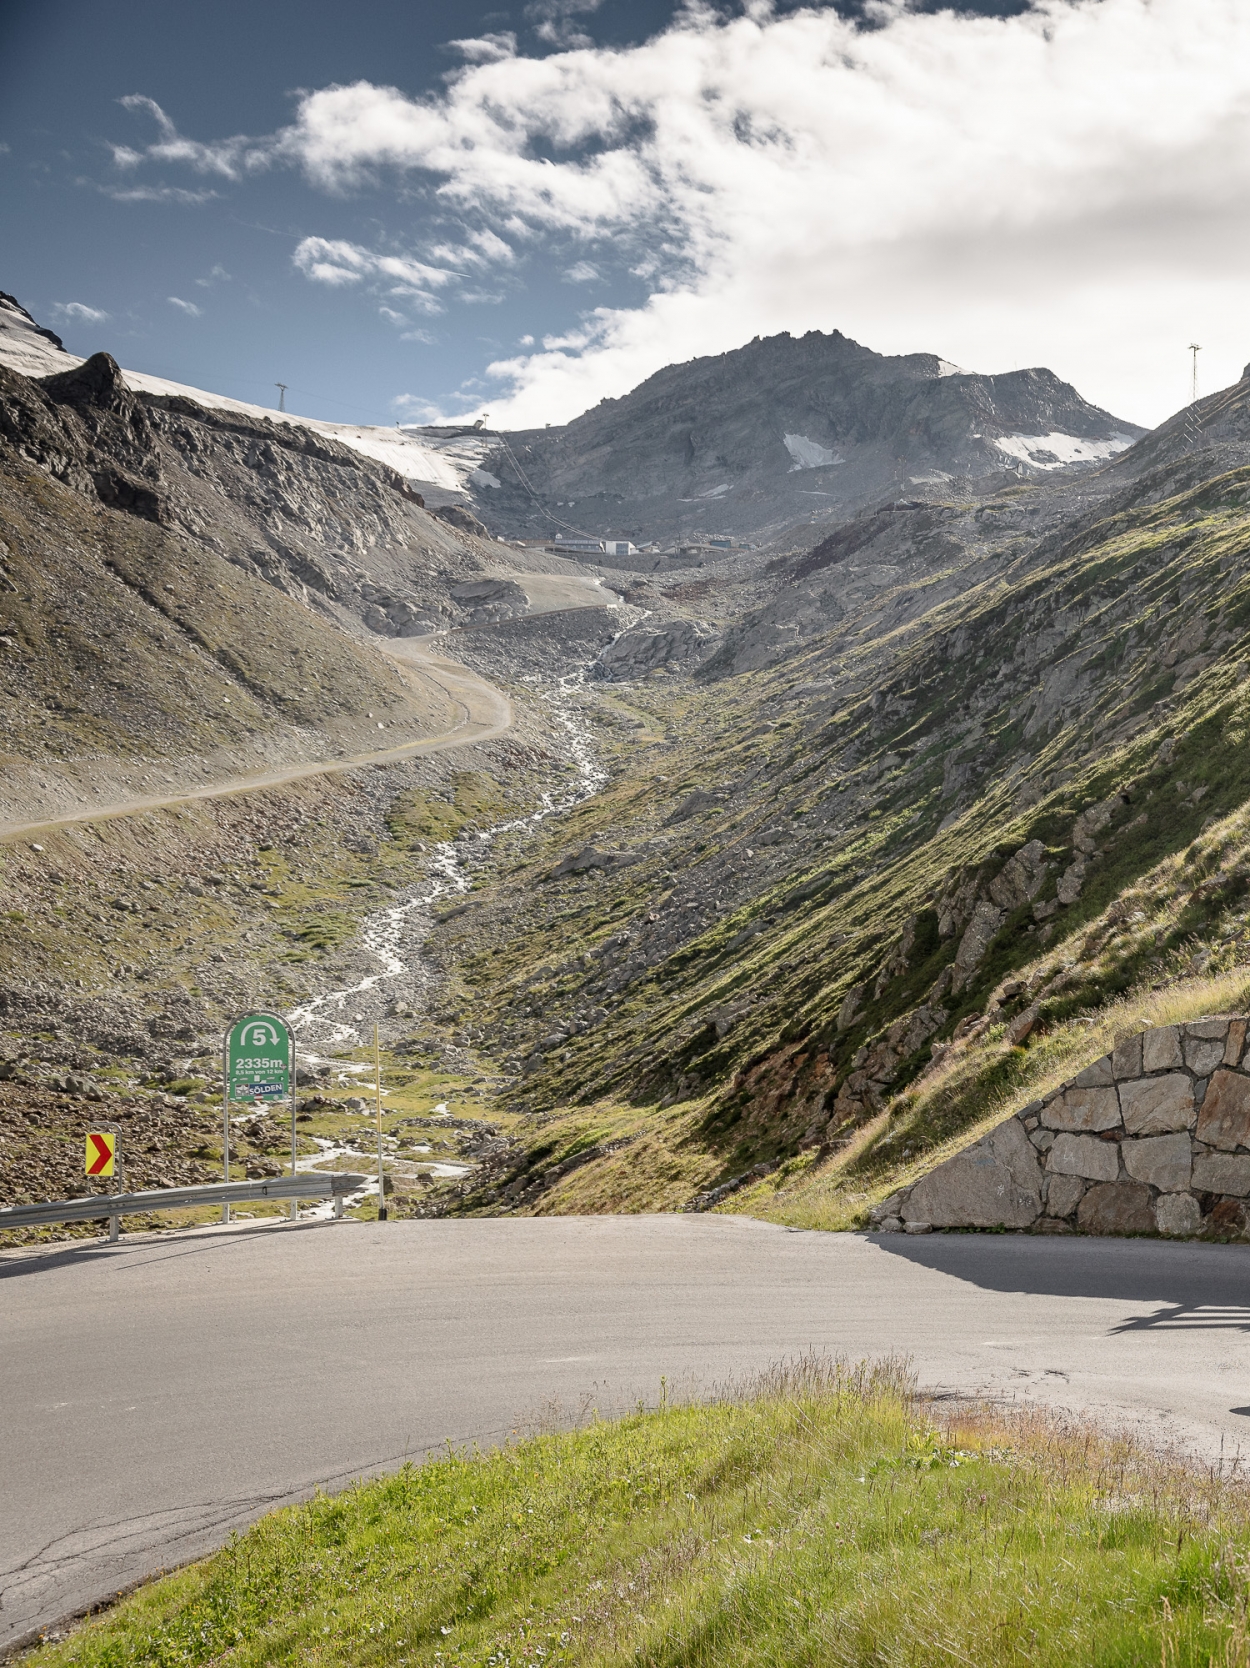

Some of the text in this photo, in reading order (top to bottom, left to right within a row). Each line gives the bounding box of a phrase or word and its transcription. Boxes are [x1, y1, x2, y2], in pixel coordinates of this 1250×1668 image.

[252, 1029, 266, 1046] 5
[236, 1058, 283, 1068] 2335m
[249, 1084, 283, 1095] SÖLDEN
